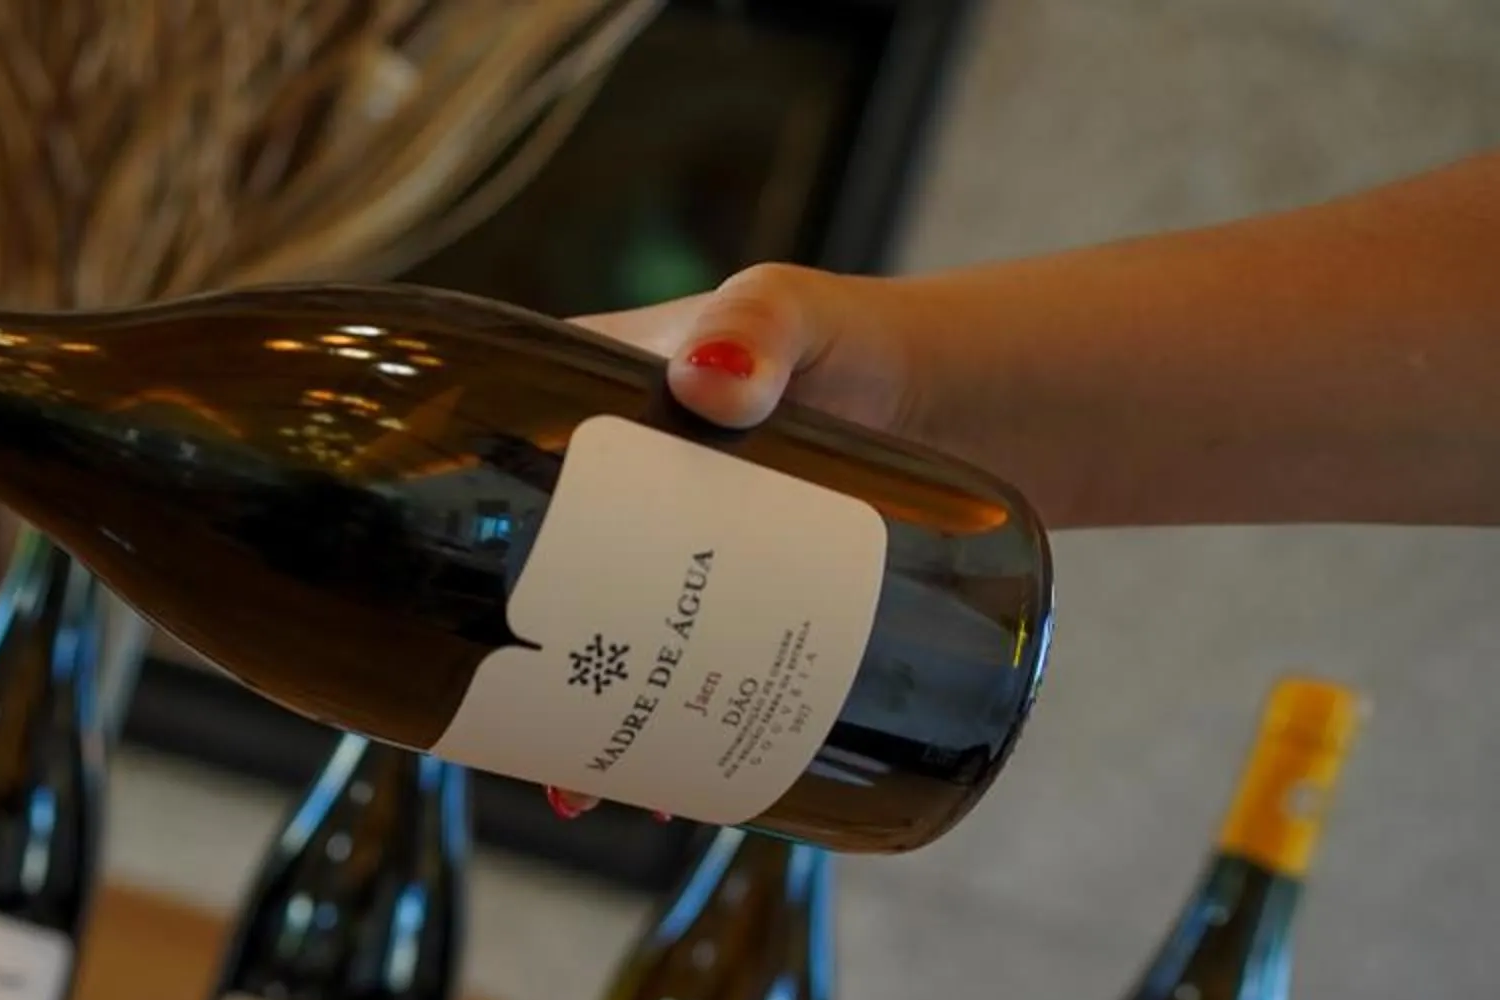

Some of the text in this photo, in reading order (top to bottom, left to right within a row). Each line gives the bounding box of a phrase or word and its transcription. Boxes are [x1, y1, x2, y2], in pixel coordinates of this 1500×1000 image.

[585, 548, 715, 774] MADRE DE ÁGUA
[684, 670, 722, 717] Jaen
[721, 676, 758, 727] DÃO
